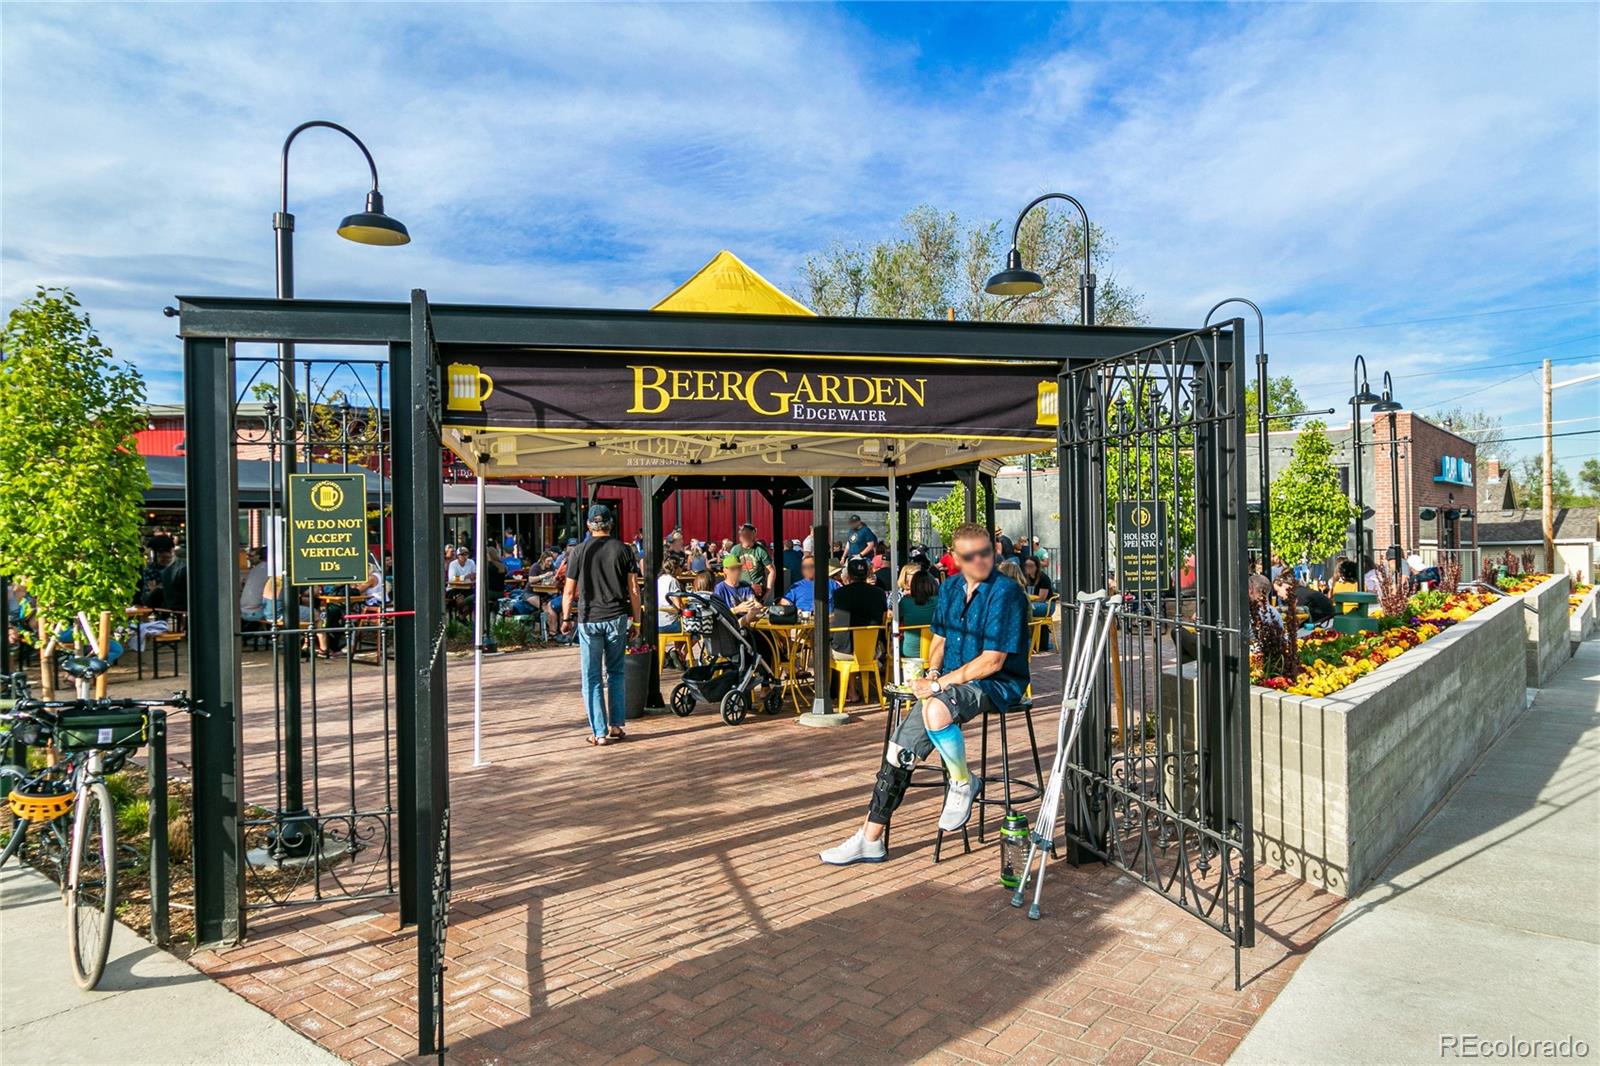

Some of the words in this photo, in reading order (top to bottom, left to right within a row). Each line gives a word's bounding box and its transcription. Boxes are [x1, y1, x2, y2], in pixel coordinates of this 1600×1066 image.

[793, 404, 887, 422] EDGEWATER
[295, 520, 315, 529] WE
[317, 520, 335, 529] DO
[337, 519, 362, 528] NOT
[307, 533, 352, 543] ACCEPT
[1123, 540, 1163, 548] PEATIO
[301, 547, 359, 557] VERTICAL
[320, 562, 340, 571] ID's
